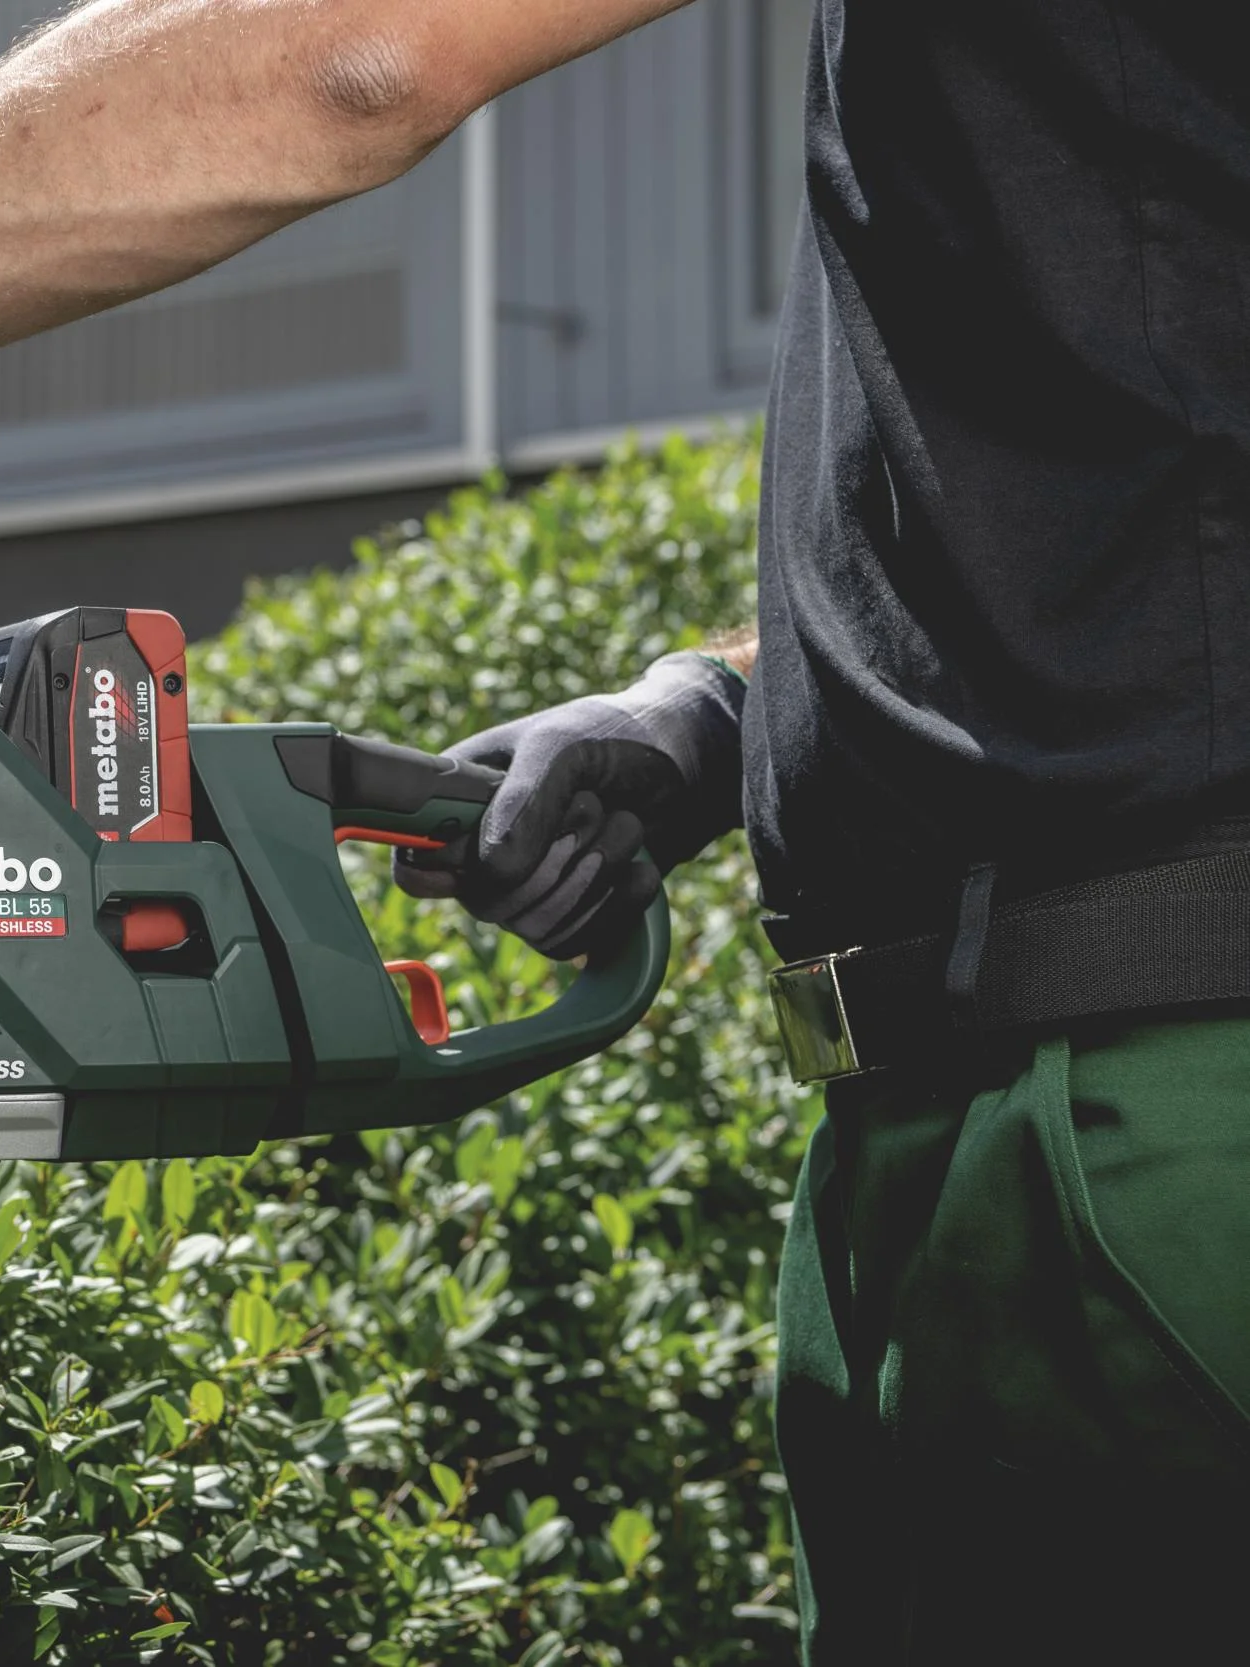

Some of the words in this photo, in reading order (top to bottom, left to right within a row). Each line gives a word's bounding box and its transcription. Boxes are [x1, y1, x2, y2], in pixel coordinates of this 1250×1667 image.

[136, 681, 149, 713] LiHD
[88, 668, 119, 816] metabo
[137, 716, 150, 743] 18V
[29, 897, 52, 915] 55
